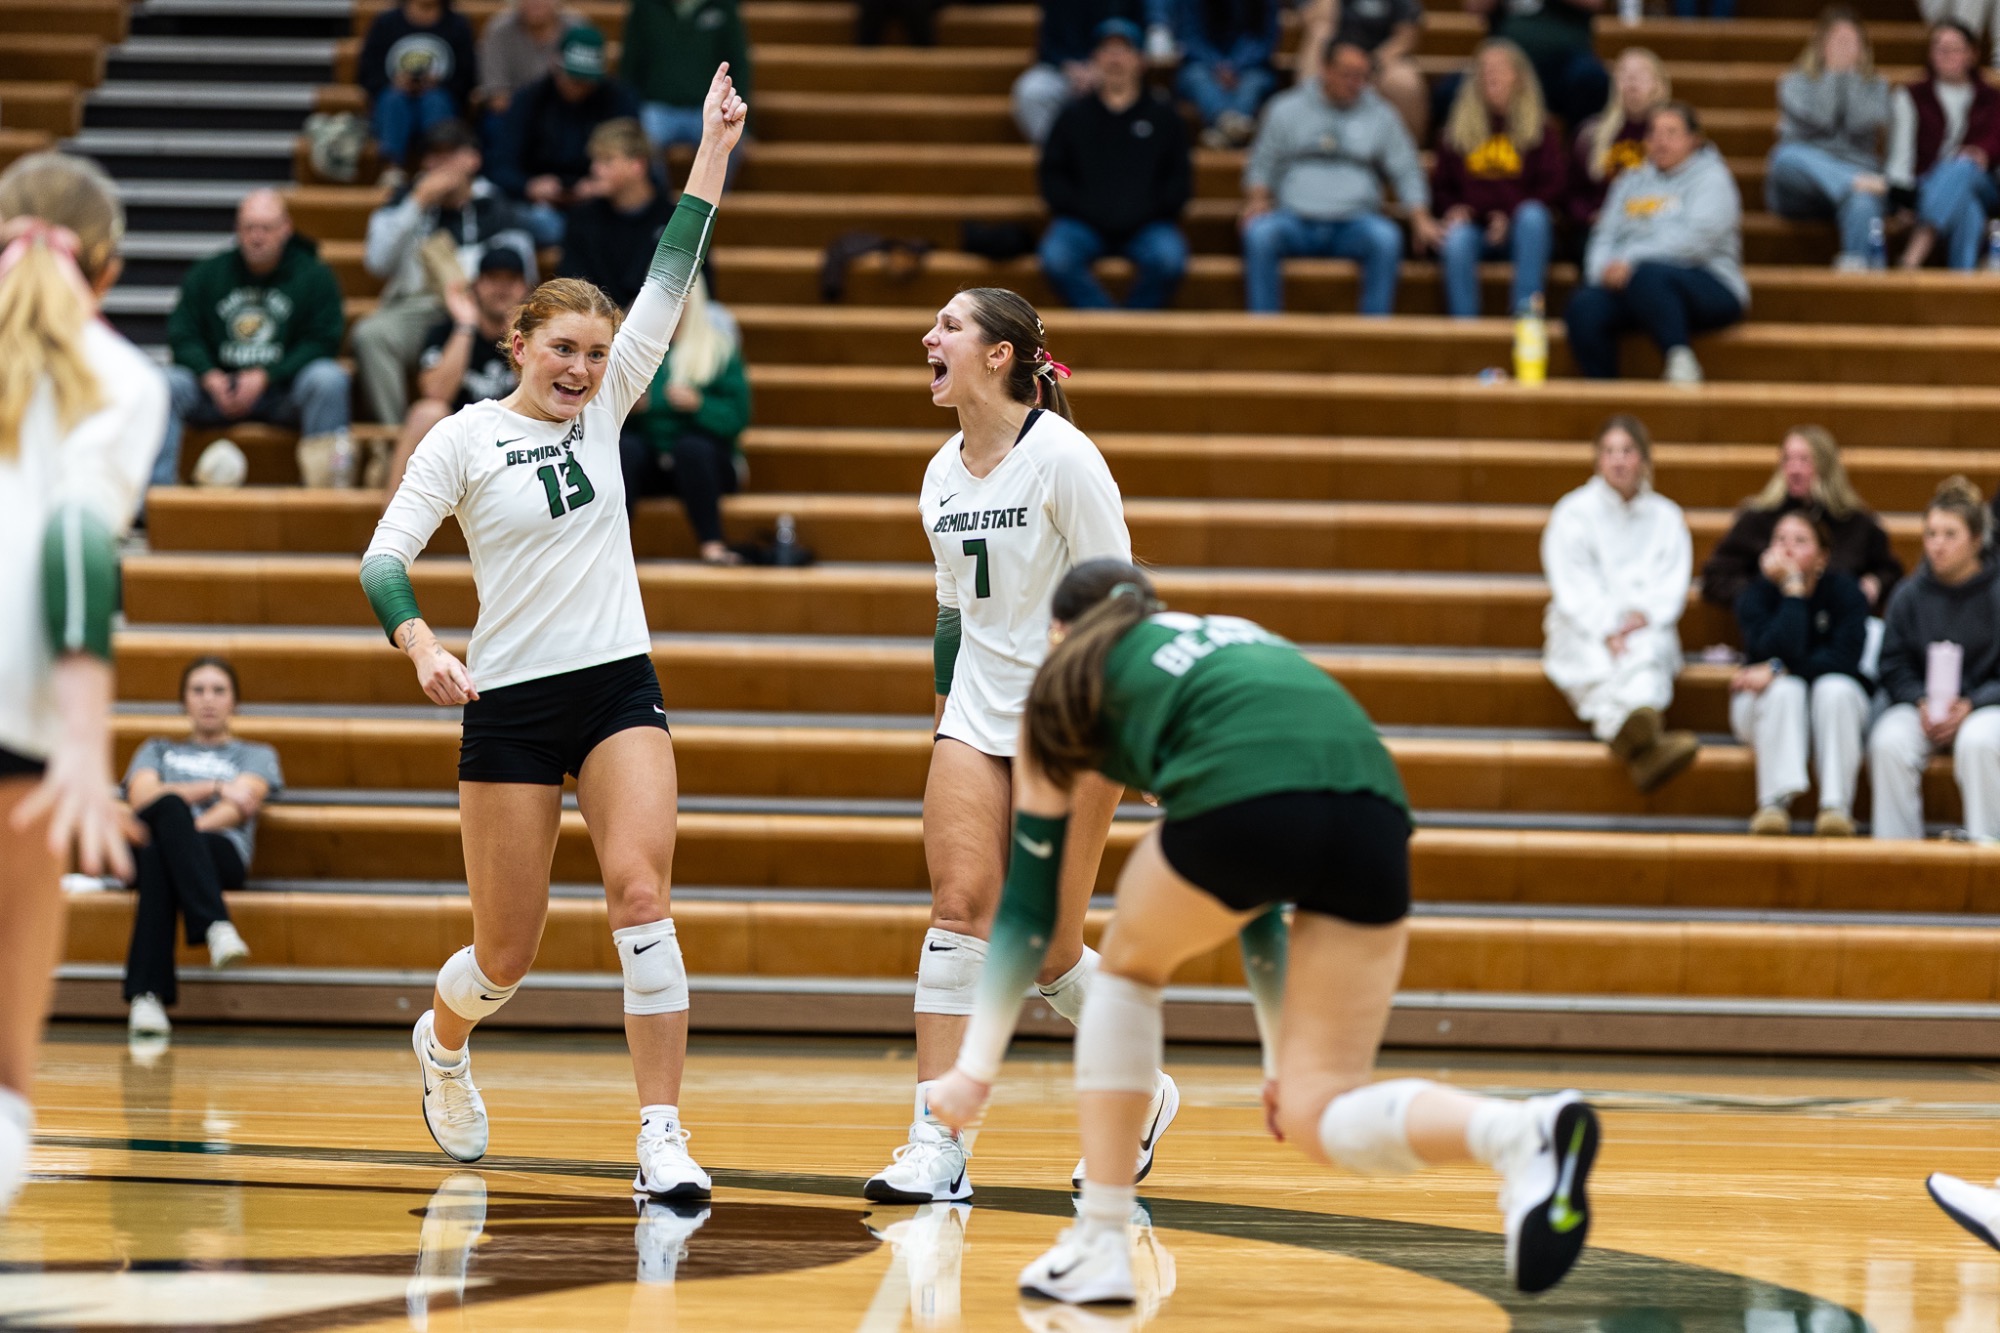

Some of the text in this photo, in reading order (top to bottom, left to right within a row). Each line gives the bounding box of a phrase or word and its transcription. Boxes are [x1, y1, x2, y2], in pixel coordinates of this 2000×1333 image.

[537, 451, 595, 520] 13
[933, 507, 1028, 533] BEMIDJI STATE
[962, 538, 991, 599] 7
